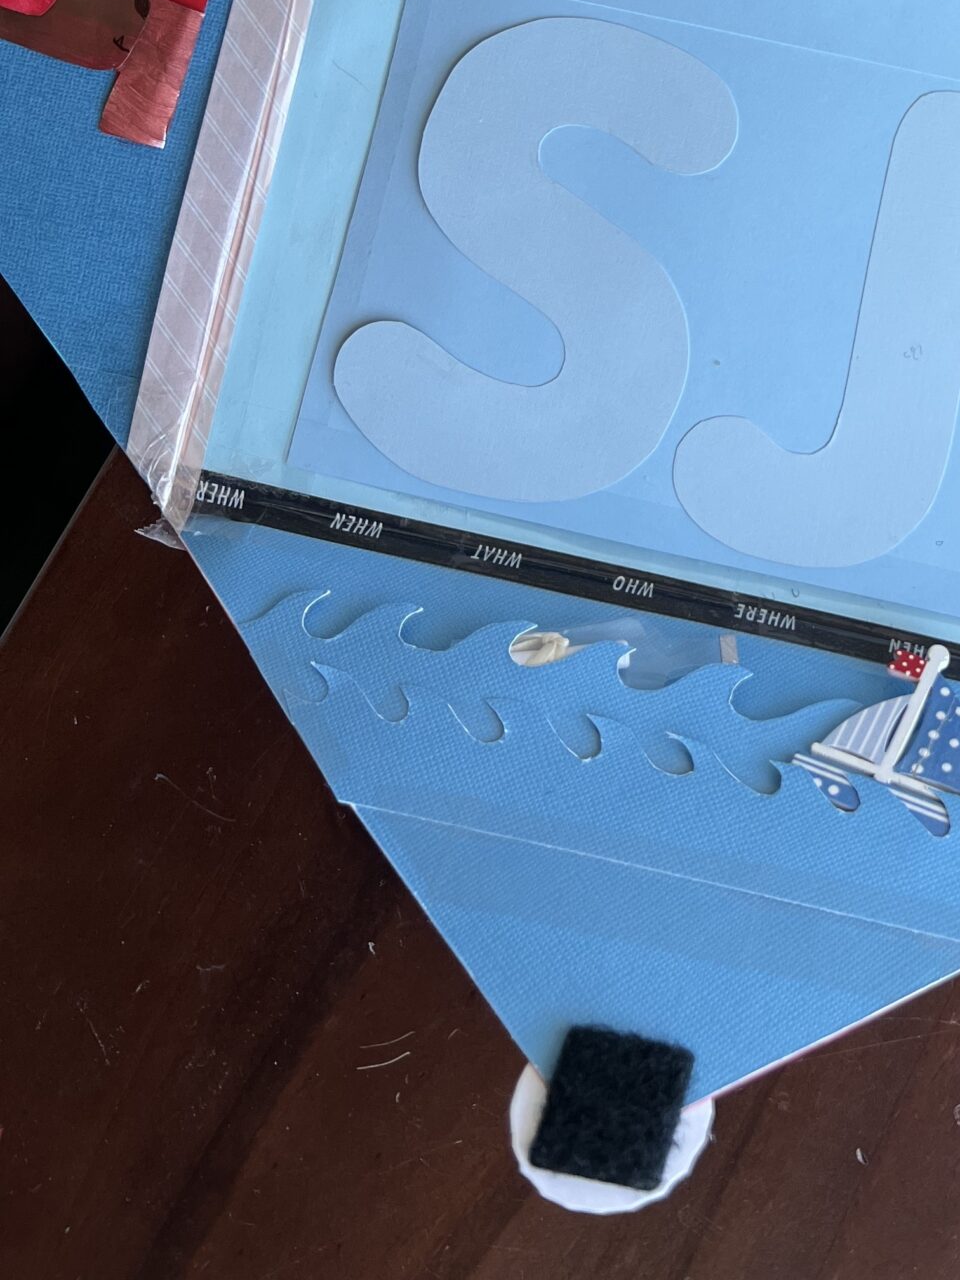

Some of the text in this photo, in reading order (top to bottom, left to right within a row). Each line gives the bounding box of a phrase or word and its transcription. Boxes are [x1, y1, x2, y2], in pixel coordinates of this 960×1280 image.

[195, 480, 245, 510] WHER
[329, 512, 384, 539] WHEN
[470, 544, 523, 569] WHAT
[612, 575, 655, 599] WHO
[734, 603, 796, 630] WHERE
[888, 638, 930, 660] HEN
